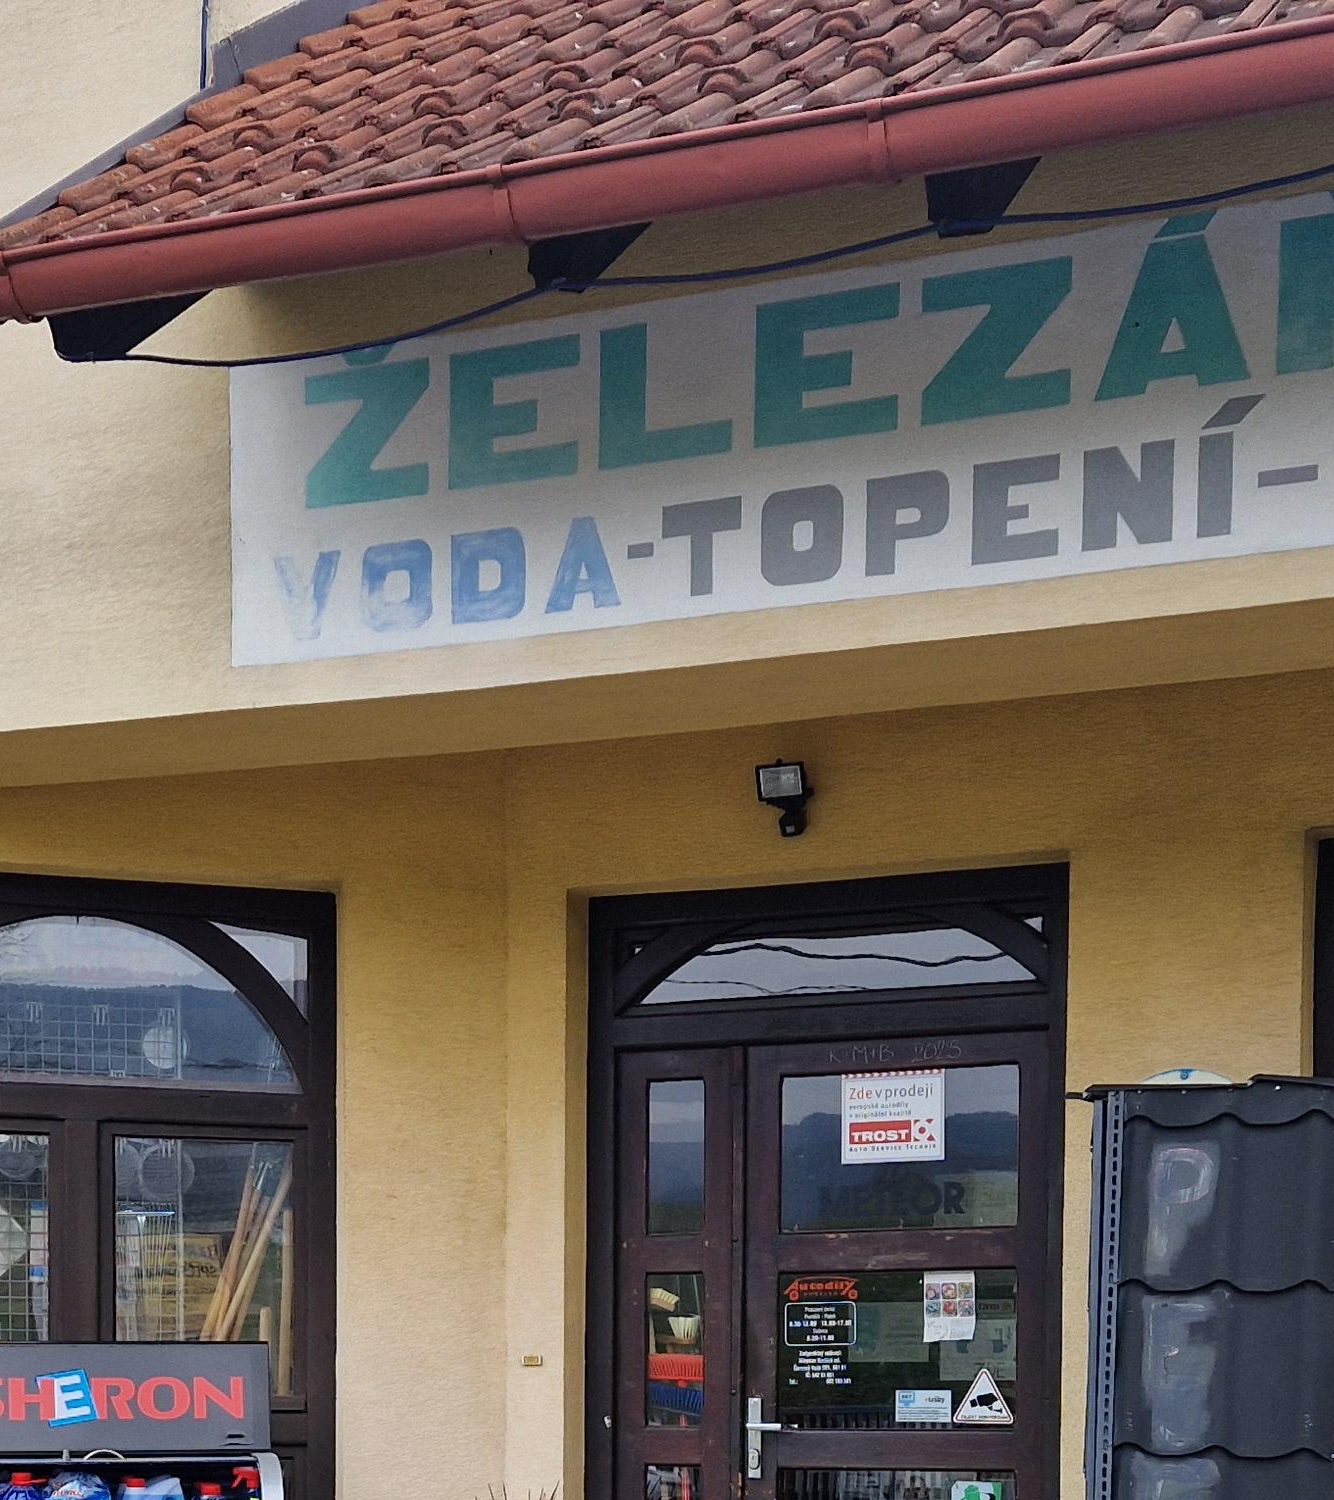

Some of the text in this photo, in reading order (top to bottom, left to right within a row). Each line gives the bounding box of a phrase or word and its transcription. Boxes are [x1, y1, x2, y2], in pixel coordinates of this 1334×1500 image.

[849, 1087, 873, 1101] Zde
[884, 1083, 934, 1102] prodeji
[851, 1129, 910, 1142] TROST
